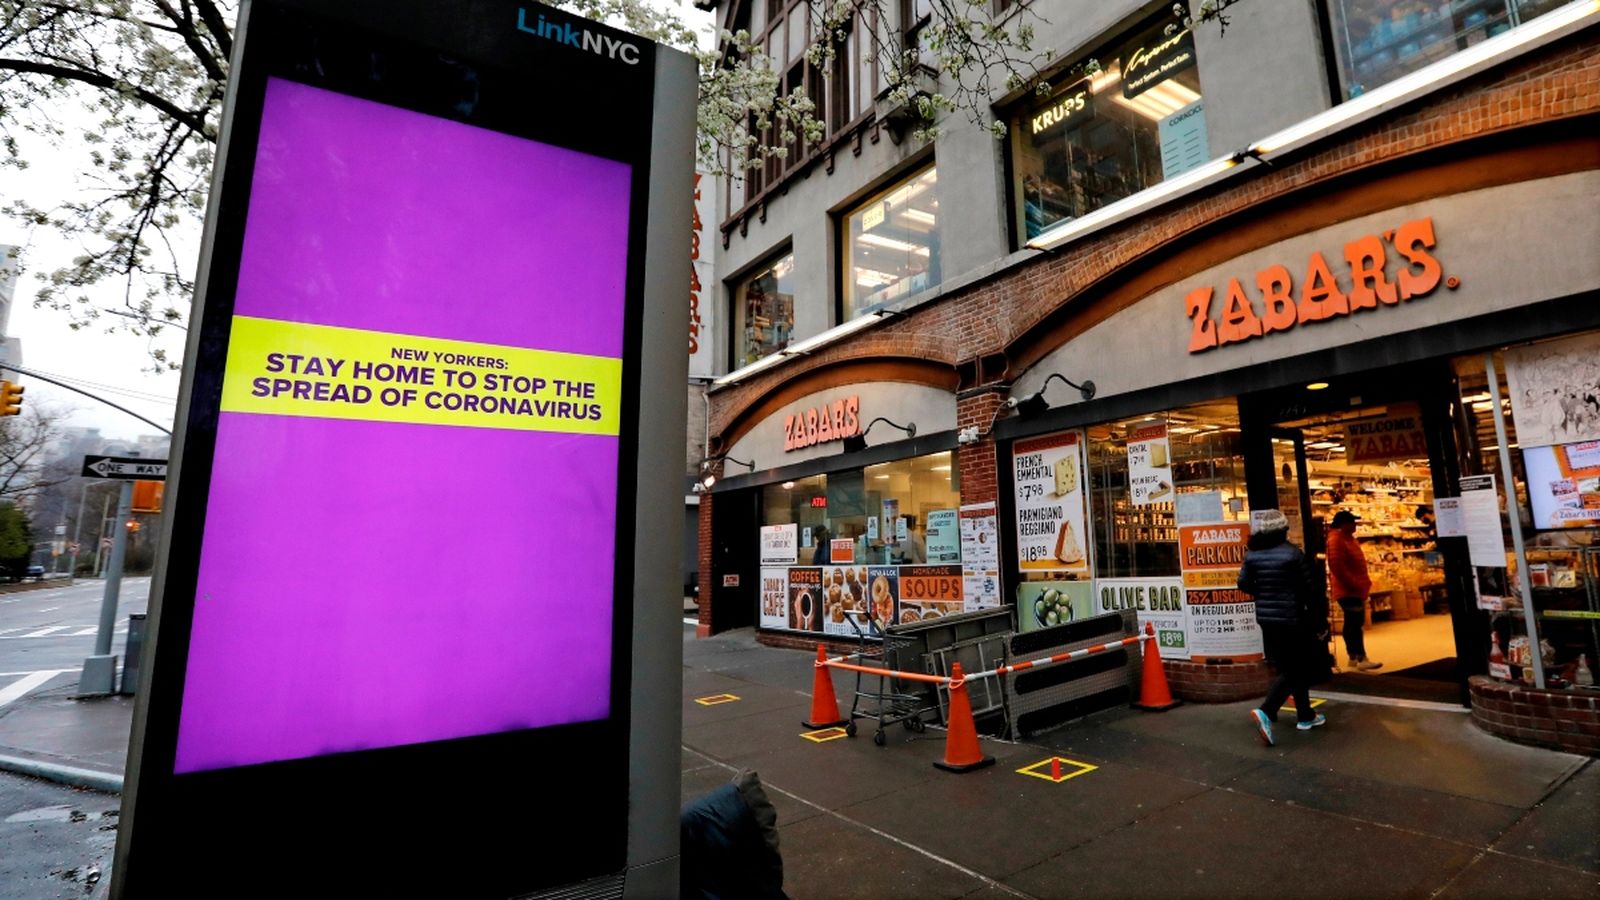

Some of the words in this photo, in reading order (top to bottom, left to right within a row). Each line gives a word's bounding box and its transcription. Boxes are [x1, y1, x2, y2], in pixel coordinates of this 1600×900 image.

[517, 8, 640, 65] LinkNYC
[1032, 92, 1085, 135] KRUPS
[1185, 216, 1443, 354] ZABAR'S
[391, 347, 429, 362] NEW
[434, 350, 509, 369] YORKERS:
[265, 352, 345, 378] STAY
[352, 361, 435, 385] HOME
[442, 369, 478, 389] TO
[484, 373, 547, 395] STOP
[553, 379, 596, 399] THE
[251, 376, 372, 404] SPREAD
[380, 387, 418, 408] OF
[424, 391, 602, 421] CORONAVIRUS
[1350, 417, 1415, 436] WELCOME
[97, 463, 125, 474] ONE
[136, 464, 163, 474] WAY
[1017, 464, 1053, 481] EMMENTAL
[811, 497, 828, 508] ATM
[1020, 521, 1056, 537] REGGIANO
[790, 571, 820, 583] COFFEE
[905, 578, 960, 599] SOUPS
[1101, 586, 1145, 611] OLIVE
[1149, 586, 1182, 611] BAR
[1188, 591, 1211, 604] 25%
[1191, 606, 1201, 616] ON
[1202, 604, 1234, 616] REGULAR
[1235, 603, 1255, 614] RATES
